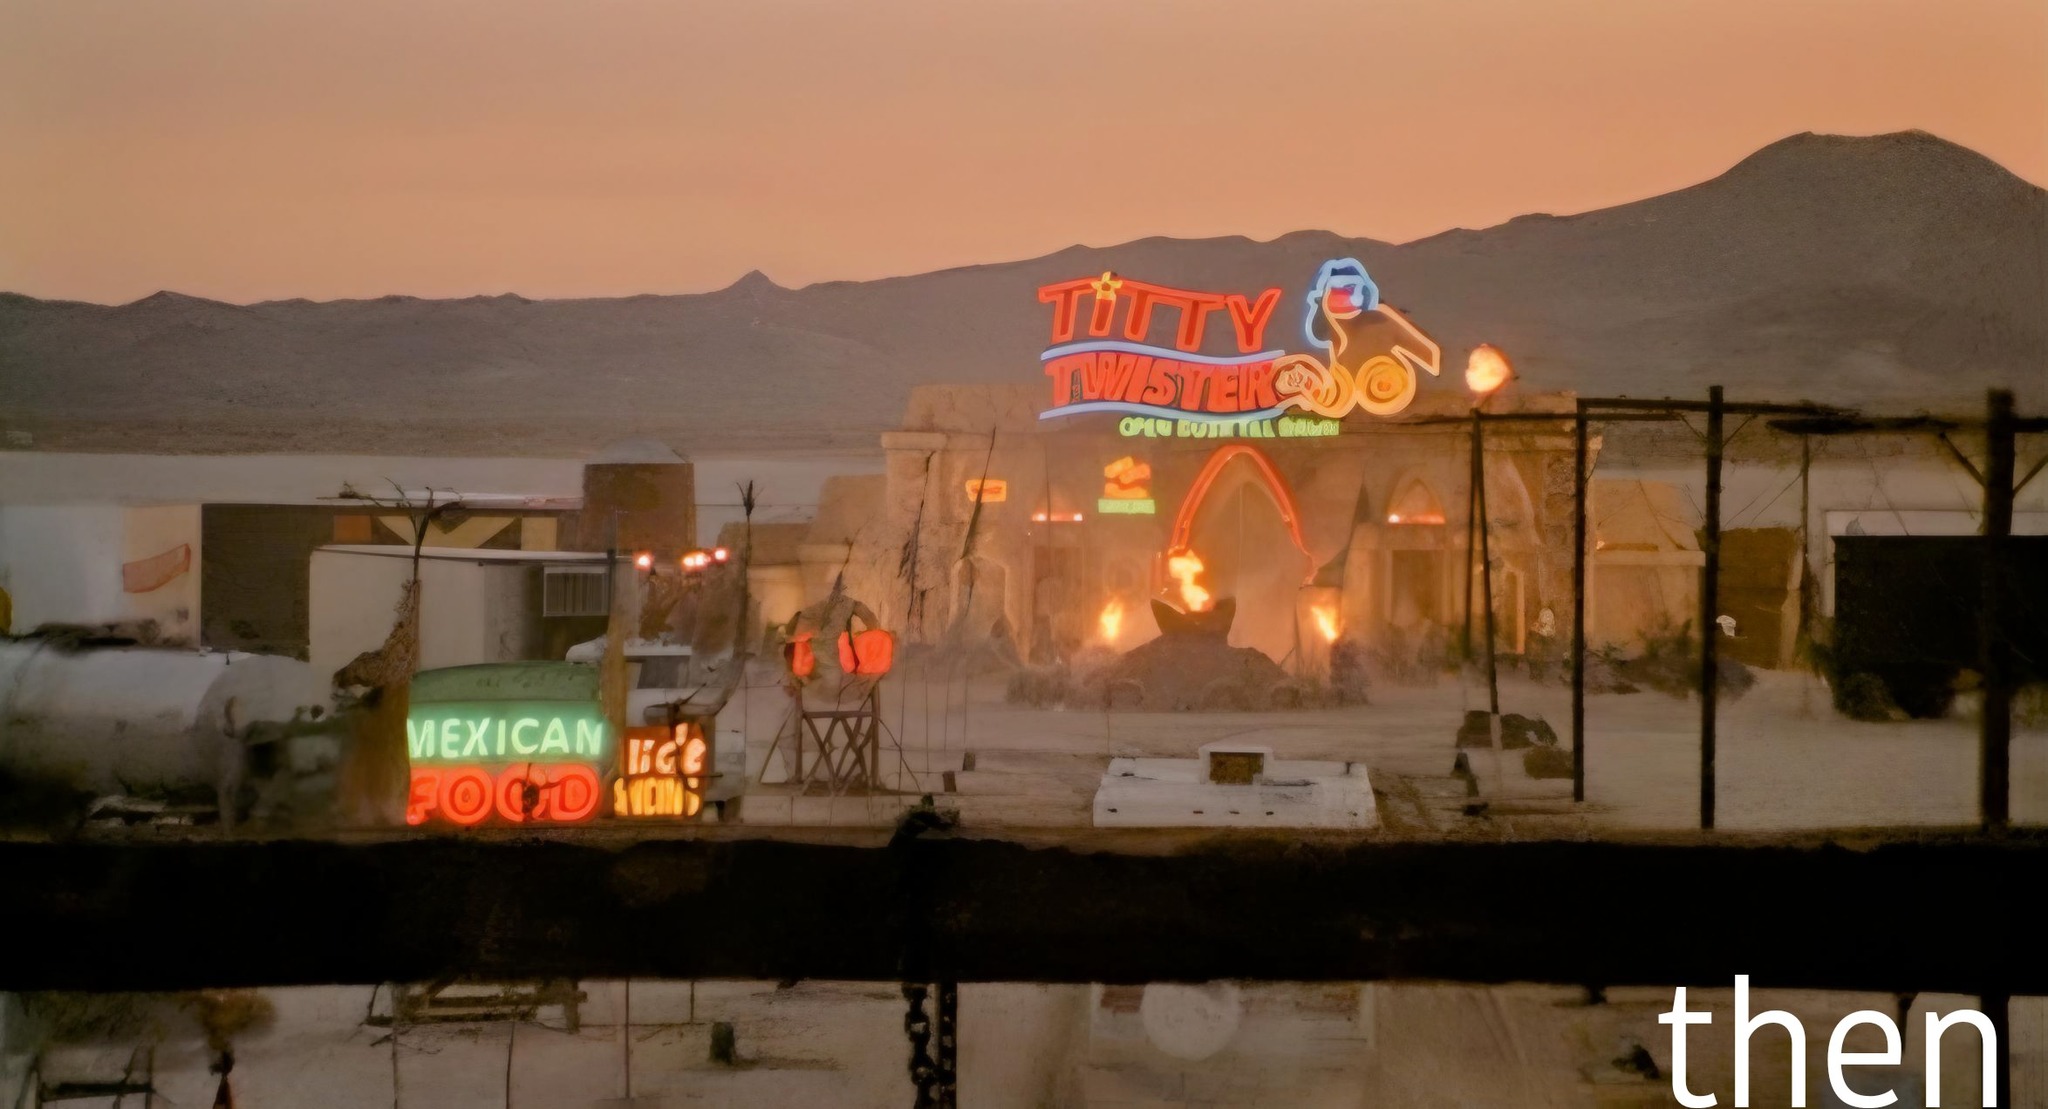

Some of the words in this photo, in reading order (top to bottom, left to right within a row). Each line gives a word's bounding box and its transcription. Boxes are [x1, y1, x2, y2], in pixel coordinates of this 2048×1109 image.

[1045, 351, 1281, 413] TWISTER
[406, 716, 604, 759] MEXICAN
[405, 763, 600, 826] FOOD
